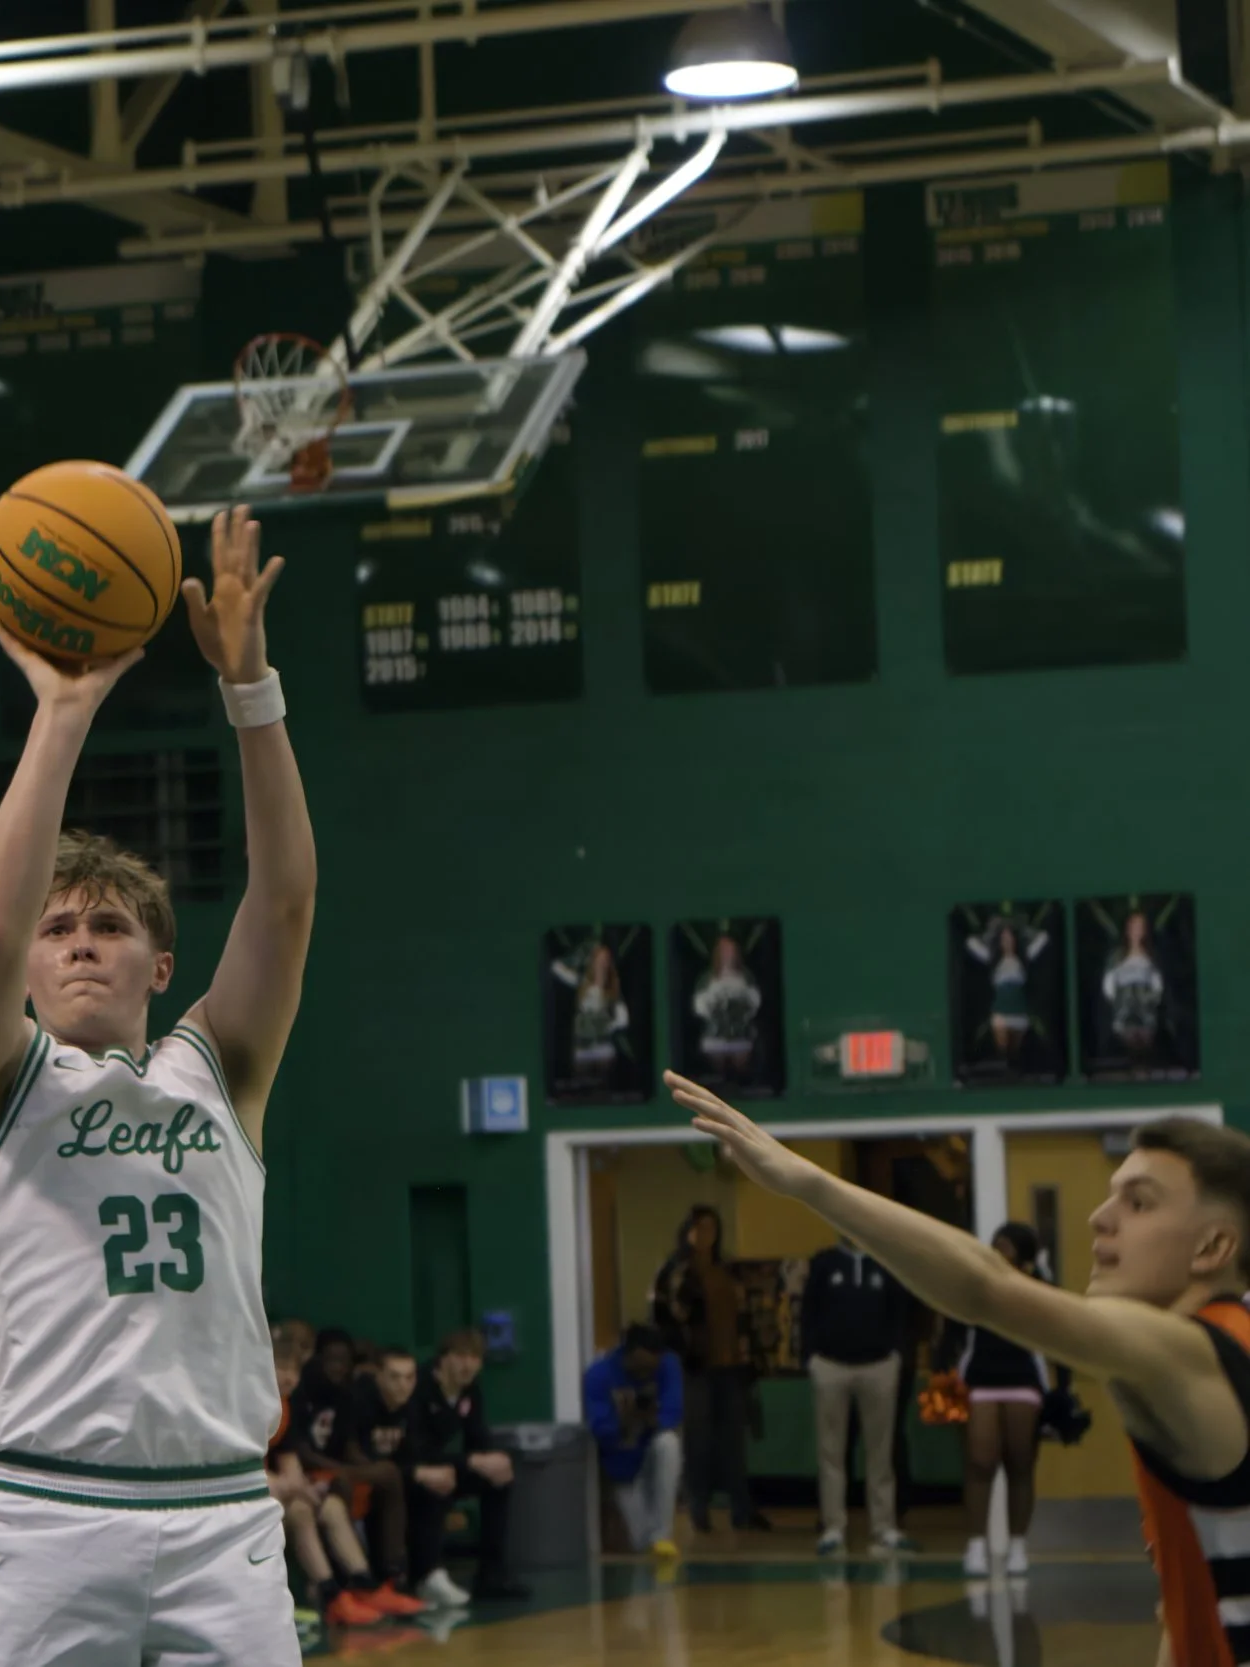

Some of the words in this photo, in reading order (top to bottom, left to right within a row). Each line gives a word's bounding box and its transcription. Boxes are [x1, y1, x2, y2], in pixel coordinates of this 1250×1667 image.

[19, 527, 111, 603] NCAA
[57, 1099, 221, 1174] Leafs
[98, 1193, 205, 1297] 23
